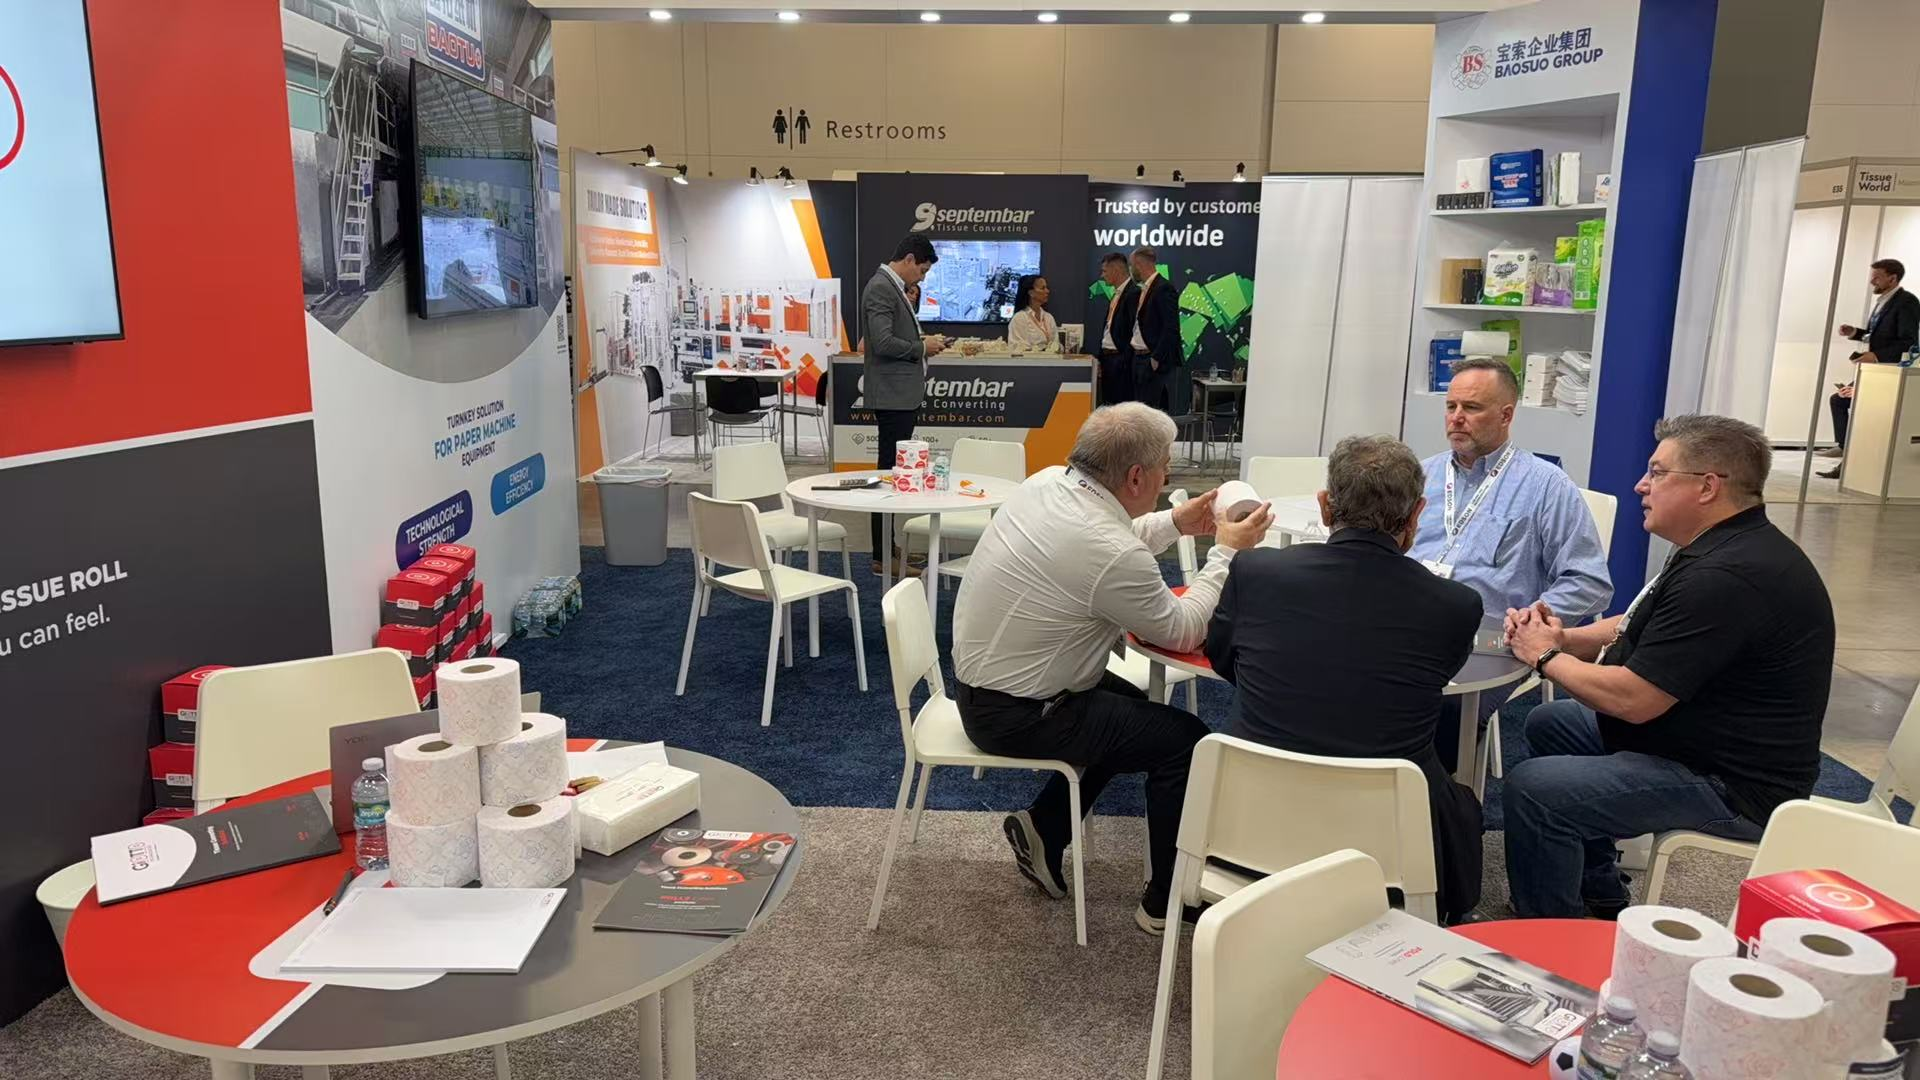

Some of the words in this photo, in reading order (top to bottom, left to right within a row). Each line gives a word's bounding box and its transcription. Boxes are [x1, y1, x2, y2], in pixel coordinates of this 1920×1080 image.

[1496, 27, 1592, 64] 宝索企业集团
[1462, 53, 1484, 74] BS
[1495, 58, 1549, 78] BAOSUO
[1553, 48, 1603, 69] GROUP
[826, 120, 946, 140] Restrooms
[1858, 182, 1891, 192] World
[1859, 171, 1892, 182] Tissue
[1094, 198, 1159, 214] Trusted
[1164, 198, 1185, 217] by
[1189, 199, 1262, 214] custome
[937, 224, 969, 232] Tissue
[973, 224, 1028, 234] Converting
[1093, 223, 1224, 247] worldwide
[447, 407, 476, 429] TURNKEY
[476, 400, 505, 420] SOLUTION
[934, 399, 1006, 411] Converting
[434, 437, 452, 460] FOR
[454, 426, 481, 452] PAPER
[483, 413, 516, 440] MACHINE
[462, 441, 496, 467] EQUIPMENT
[509, 466, 529, 486] ENERGY
[505, 480, 534, 504] EFFICIENCY
[405, 501, 464, 545] TECHNOLOGICAL
[1457, 507, 1472, 529] EDSON
[418, 525, 456, 557] STRENGTH
[0, 575, 65, 613] SSUE
[70, 560, 128, 593] ROLL
[19, 622, 60, 649] can
[65, 604, 111, 634] feel.
